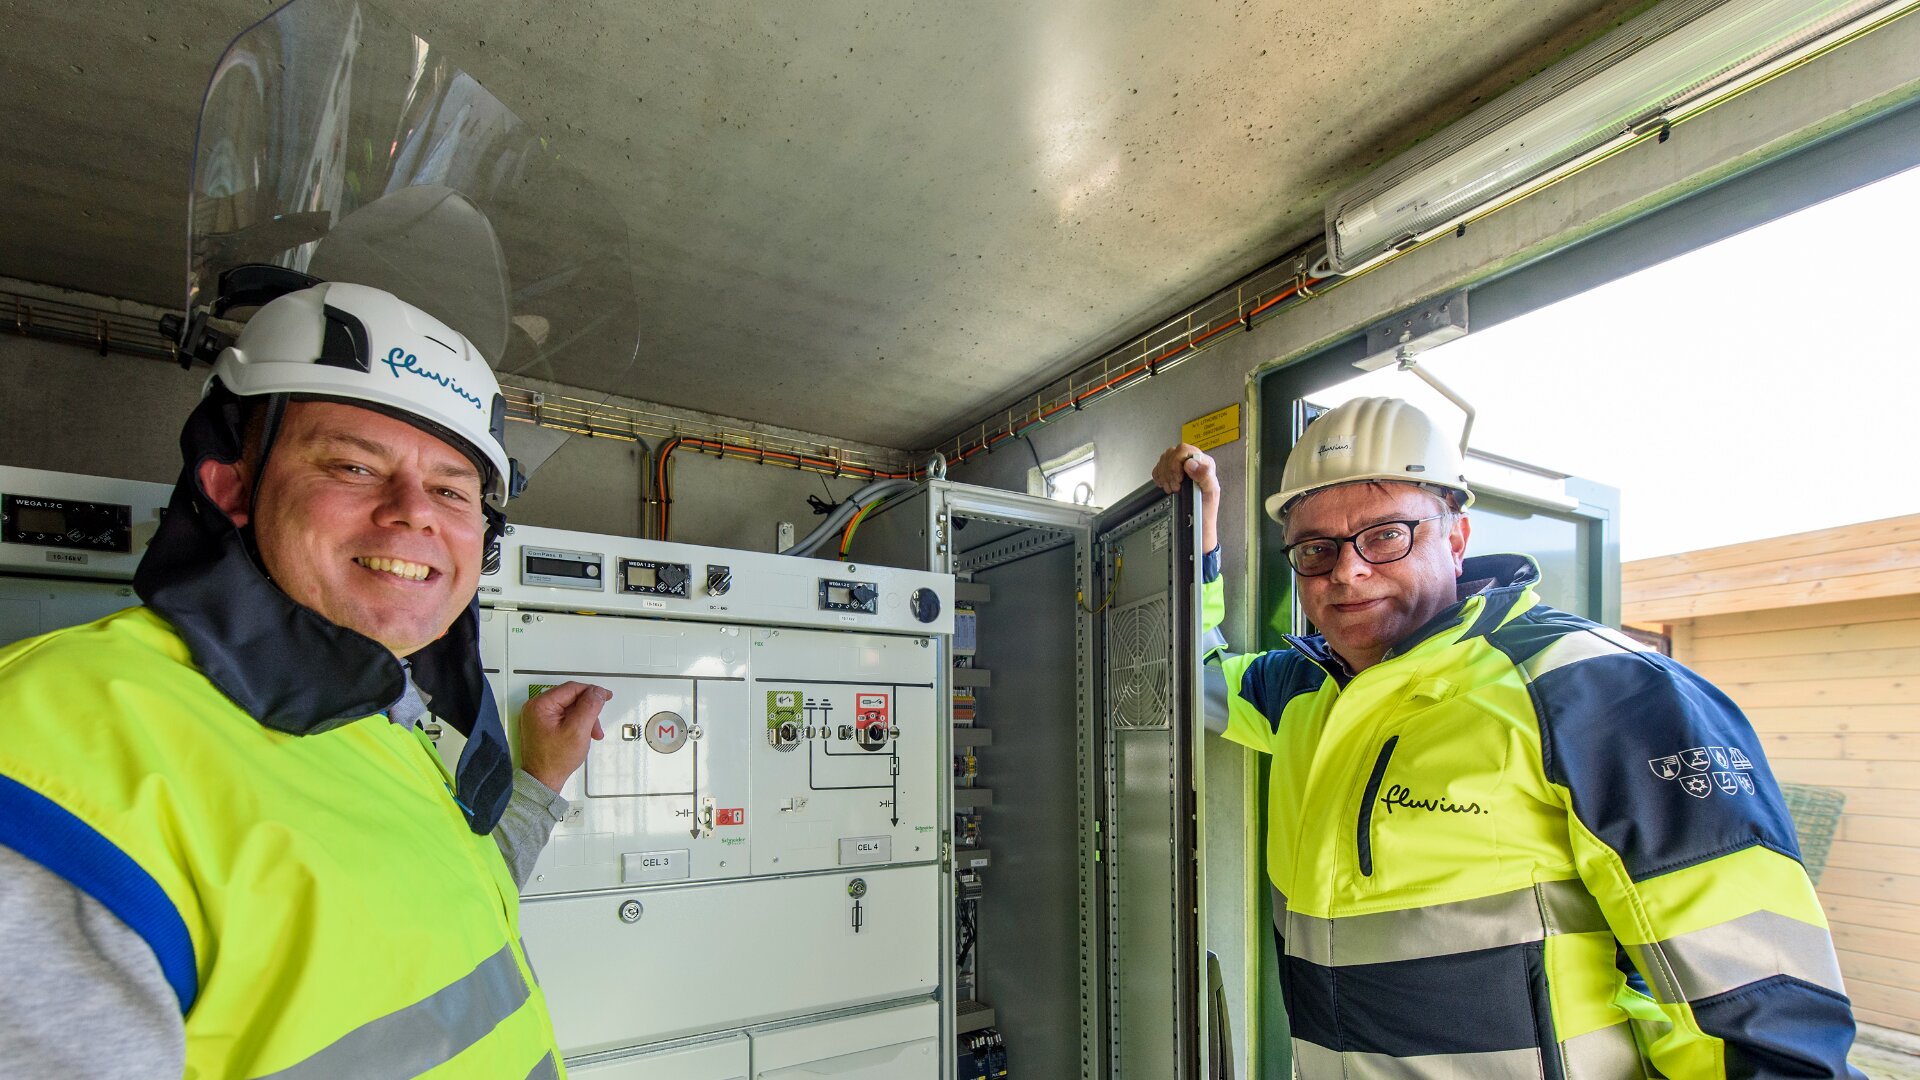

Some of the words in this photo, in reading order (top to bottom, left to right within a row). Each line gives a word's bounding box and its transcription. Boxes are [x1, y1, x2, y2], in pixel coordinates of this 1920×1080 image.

[16, 499, 42, 507] WEGA
[658, 725, 675, 738] M
[642, 858, 661, 867] CEL
